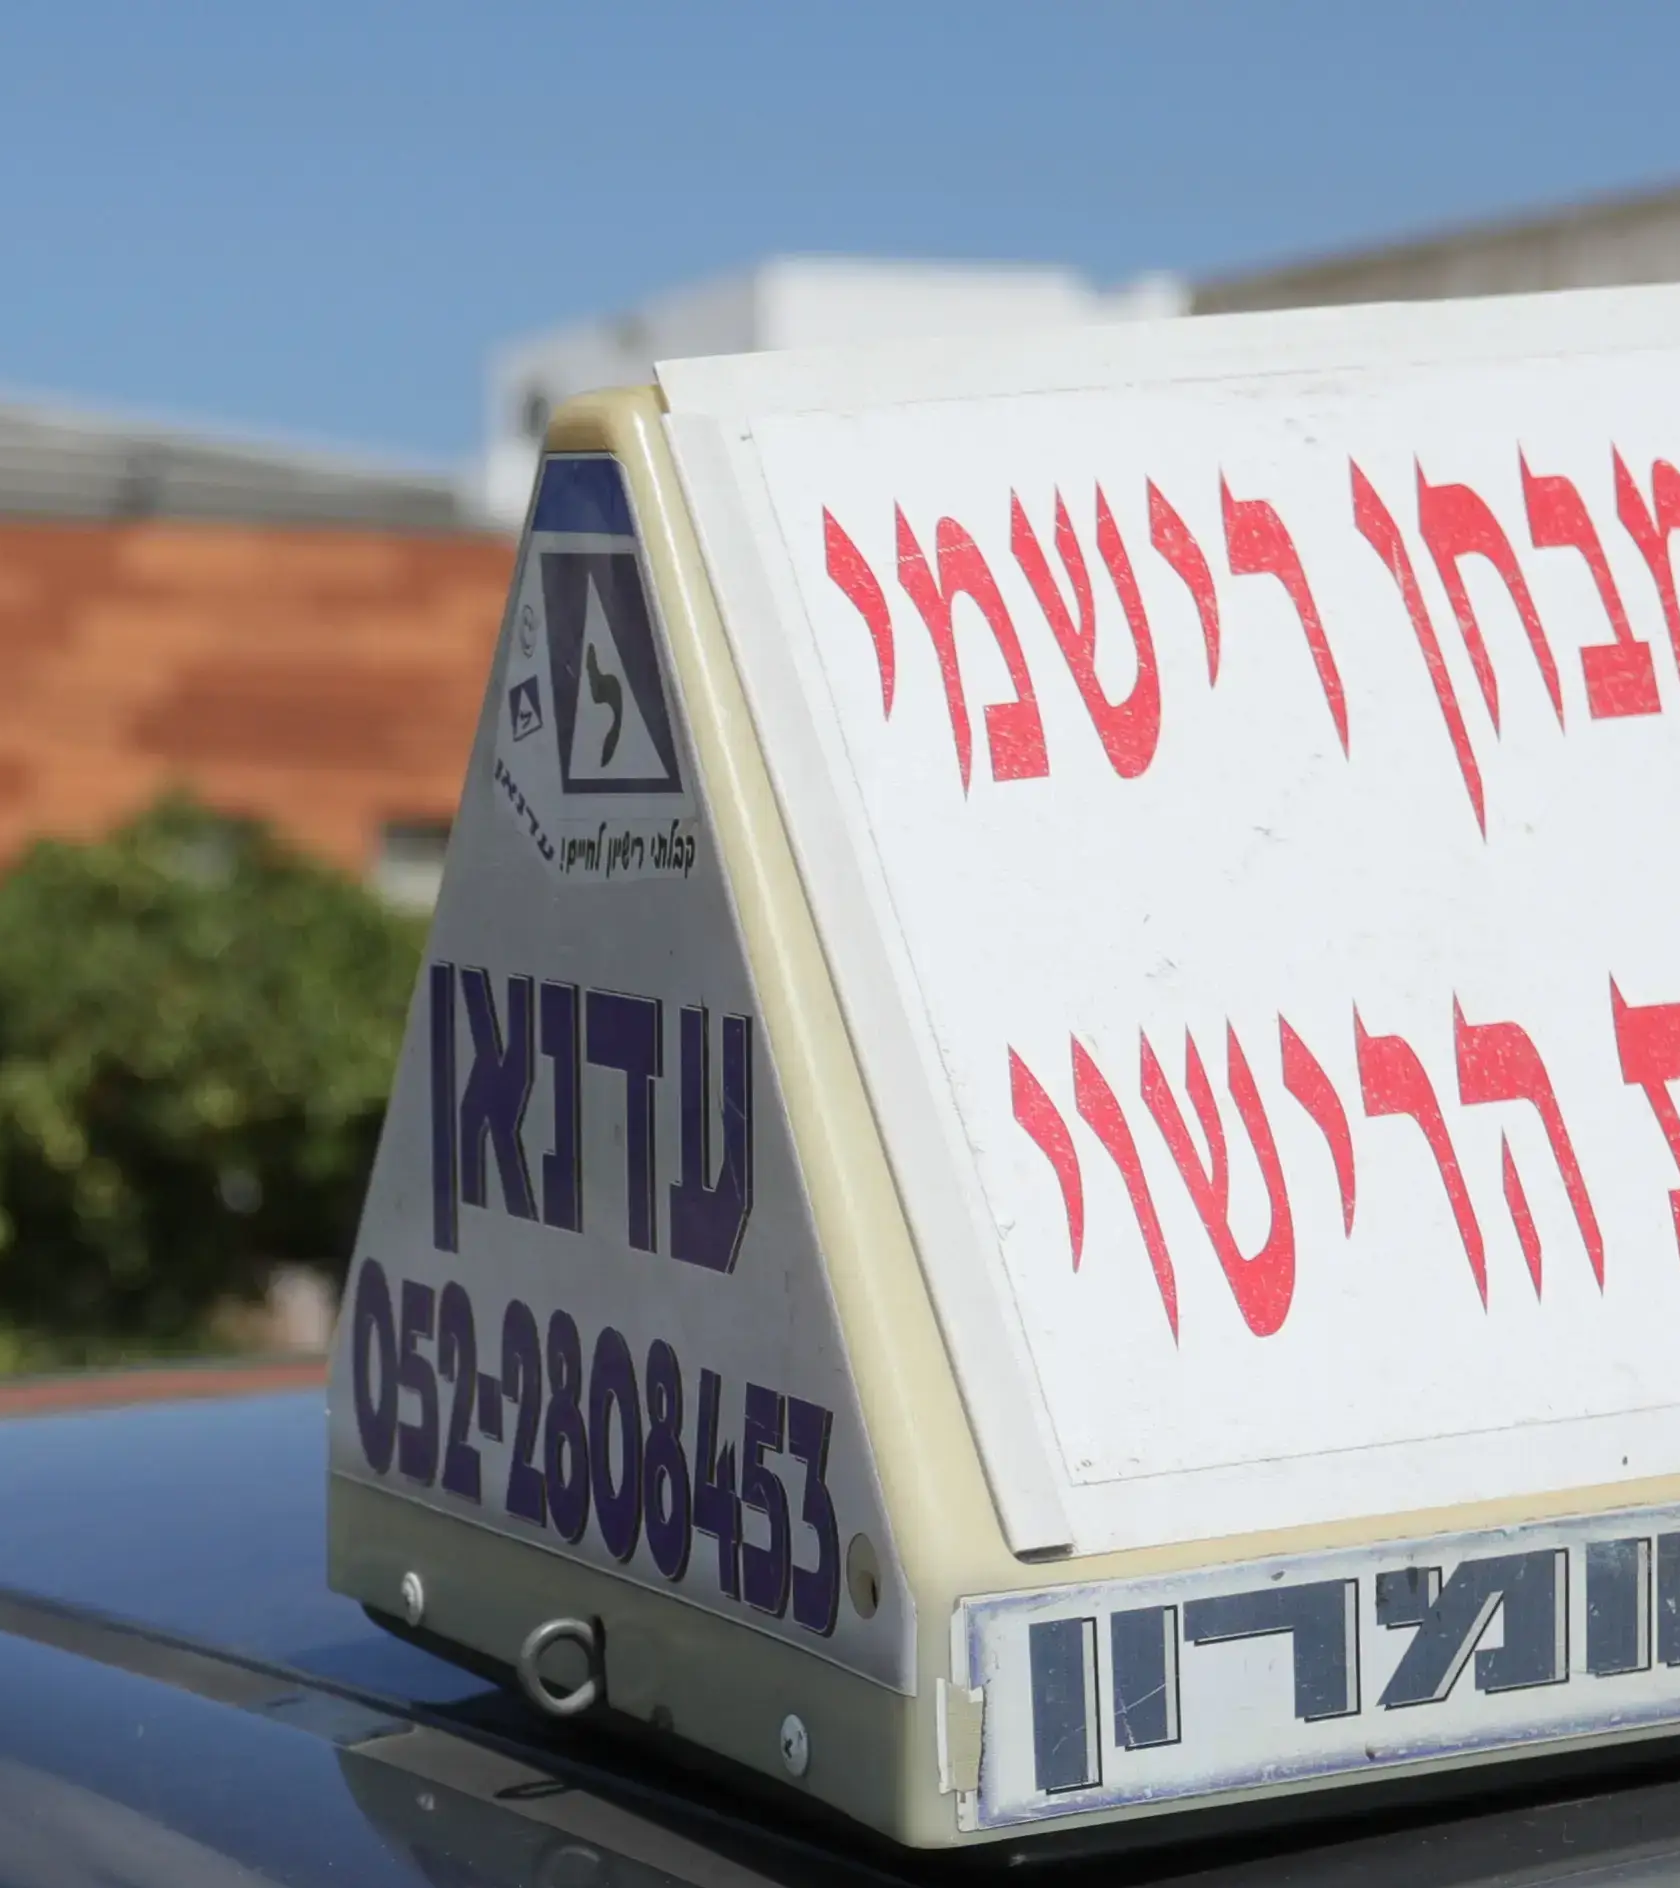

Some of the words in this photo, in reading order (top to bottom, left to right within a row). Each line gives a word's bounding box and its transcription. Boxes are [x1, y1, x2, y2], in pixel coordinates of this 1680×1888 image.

[585, 642, 624, 769] ל
[824, 482, 1348, 784] רישמי
[650, 817, 696, 879] קבלתי
[429, 960, 754, 1275] עדנאן
[1011, 1005, 1604, 1337] הרישוי
[352, 1256, 841, 1640] 052-2808453
